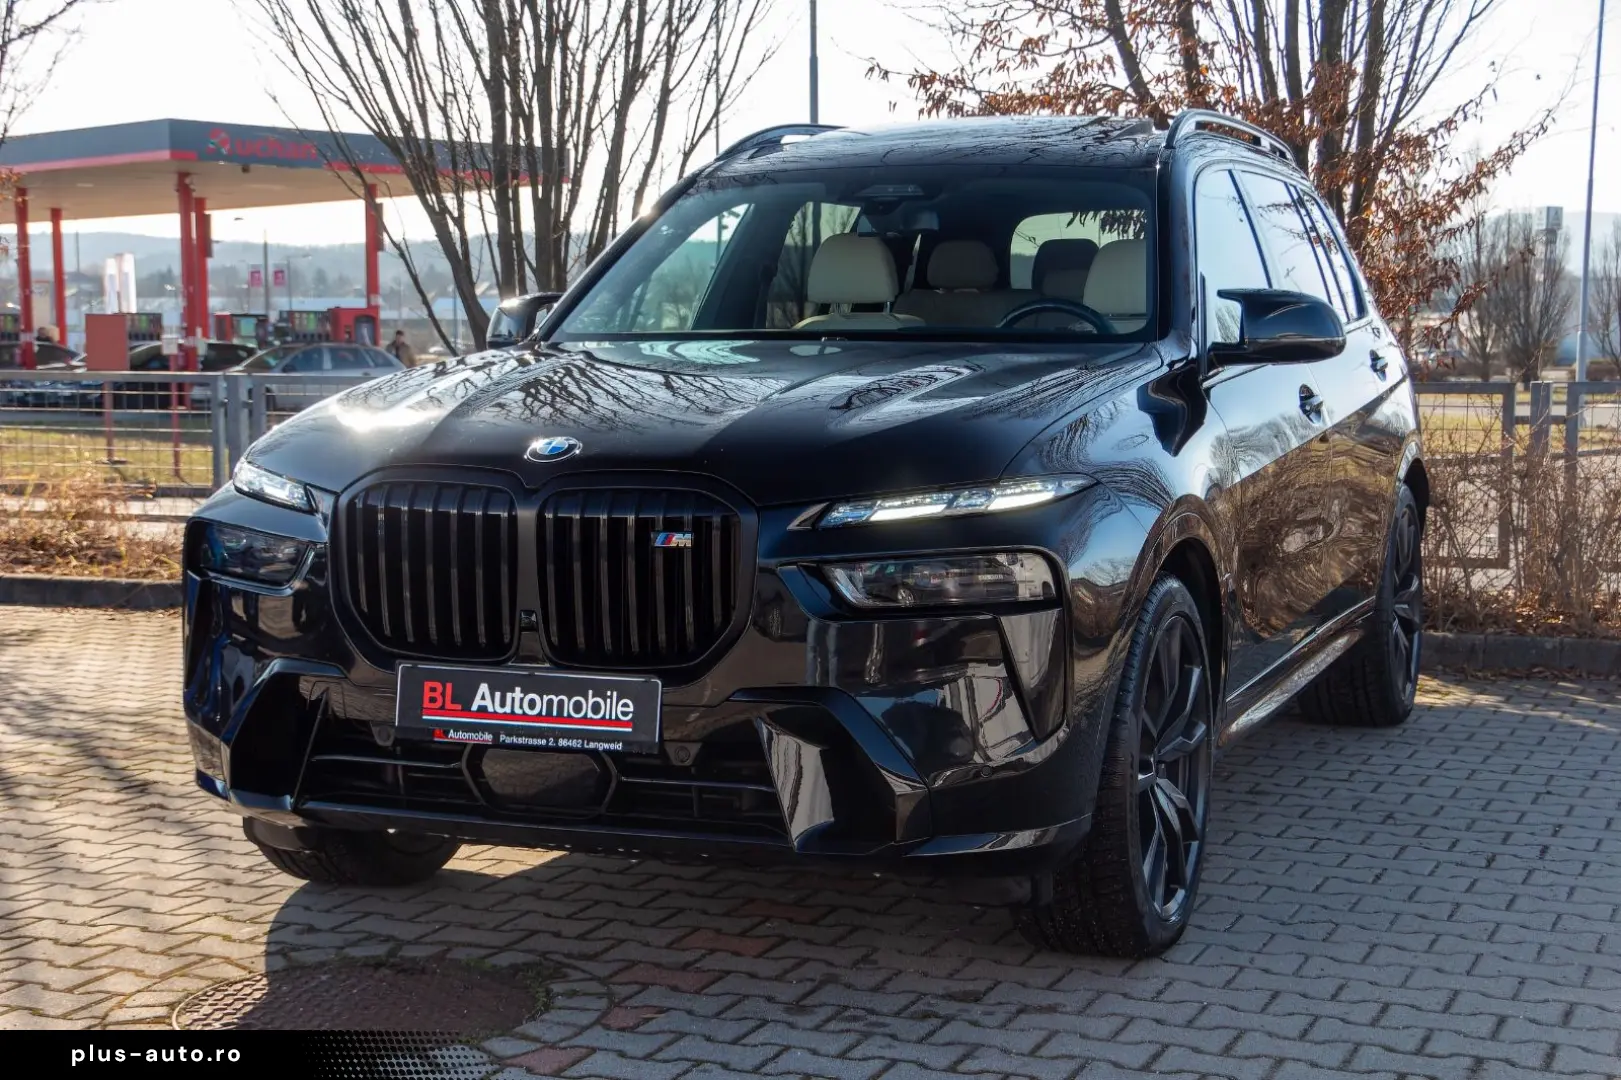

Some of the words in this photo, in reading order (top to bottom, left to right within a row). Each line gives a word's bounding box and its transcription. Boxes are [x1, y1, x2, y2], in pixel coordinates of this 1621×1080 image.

[423, 681, 462, 710] BL
[471, 683, 634, 721] Automobile
[448, 729, 493, 742] Automobile
[500, 735, 547, 746] Parkstrasse
[558, 738, 583, 748] 86462
[584, 741, 623, 751] Langweid
